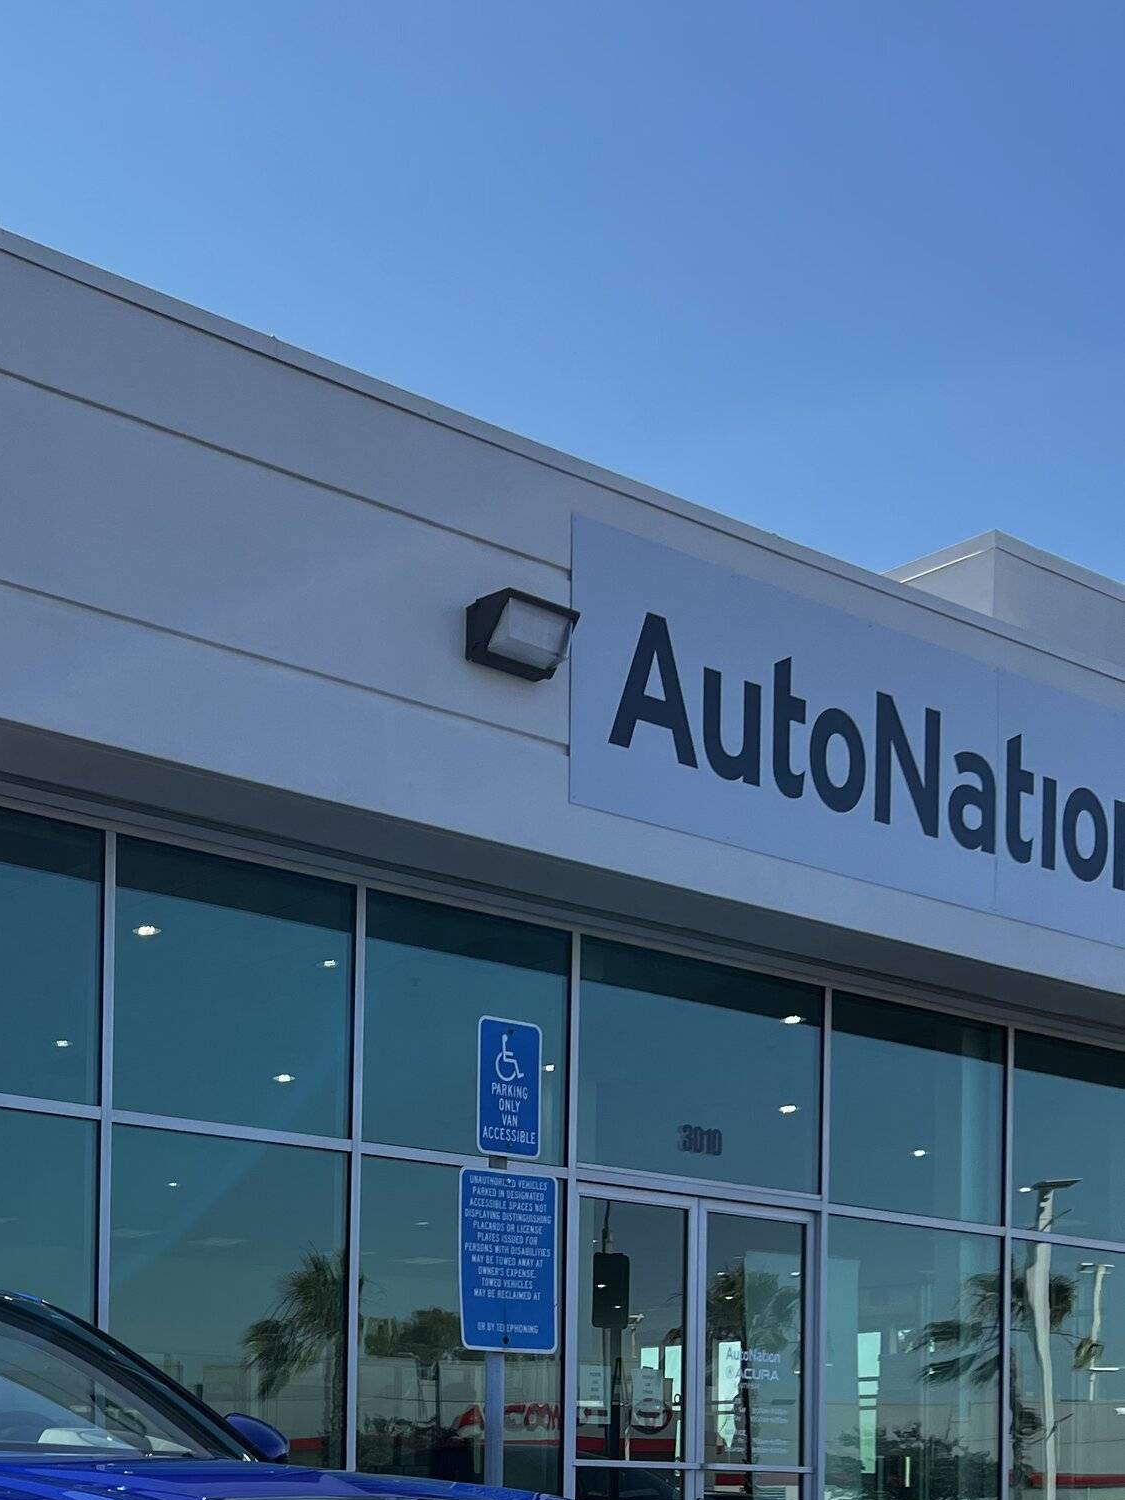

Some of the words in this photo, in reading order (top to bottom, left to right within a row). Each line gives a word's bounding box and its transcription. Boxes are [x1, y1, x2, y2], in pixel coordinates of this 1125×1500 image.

[607, 611, 1125, 891] AutoNatio
[491, 1082, 528, 1100] PARKING
[498, 1098, 521, 1113] ONLY
[501, 1113, 518, 1127] VAN
[482, 1125, 536, 1145] ACCESSIBLE
[681, 1123, 723, 1156] 3010
[469, 1175, 515, 1188] UNAUTHORID
[518, 1180, 547, 1191] VEHICLES
[472, 1186, 497, 1196] PARKED
[498, 1189, 505, 1198] IN
[507, 1190, 544, 1201] DESIGNATED
[469, 1198, 507, 1210] ACCESSIBLE
[508, 1201, 533, 1212] SPACES
[535, 1204, 547, 1213] NOT
[464, 1208, 501, 1220] DISPLAYING
[473, 1221, 505, 1232] PLACARDS
[507, 1224, 515, 1232] OR
[517, 1224, 543, 1234] LICENSE
[477, 1232, 499, 1242] PLATES
[501, 1234, 524, 1244] ISSUED
[525, 1236, 539, 1246] FOR
[464, 1242, 493, 1253] PERSONS
[495, 1245, 509, 1254] WITH
[510, 1247, 551, 1257] DISABILITIES
[471, 1254, 483, 1263] MAY
[485, 1255, 494, 1264] BE
[496, 1256, 515, 1266] TOWED
[517, 1258, 535, 1267] AWAY
[536, 1259, 543, 1268] AT
[478, 1266, 504, 1277] OWNER'S
[482, 1277, 501, 1287] TOWED
[504, 1280, 533, 1290] VEHICLES
[474, 1288, 486, 1297] MAY
[487, 1290, 495, 1298] BE
[497, 1290, 531, 1300] RECLAIMED
[533, 1292, 541, 1300] AT
[477, 1322, 485, 1331] OR
[487, 1322, 495, 1331] BY
[725, 1347, 781, 1363] AutoNation
[736, 1367, 779, 1381] ACURA
